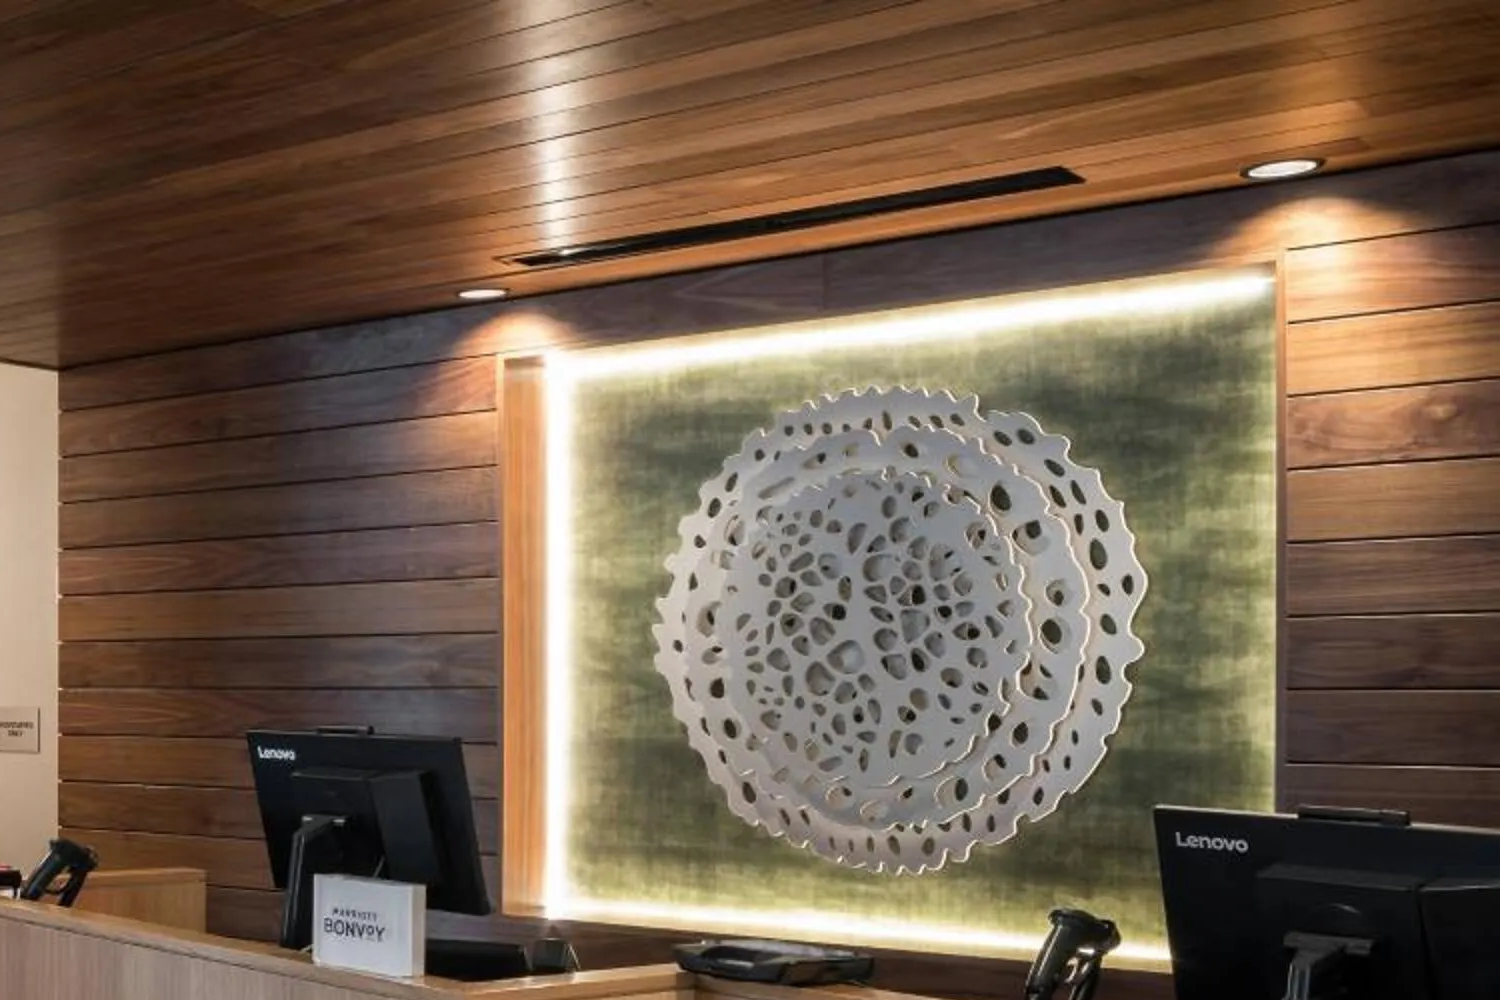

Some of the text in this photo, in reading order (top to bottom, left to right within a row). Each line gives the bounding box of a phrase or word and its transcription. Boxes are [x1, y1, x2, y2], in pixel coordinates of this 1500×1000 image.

[257, 746, 296, 761] Lenovo
[1175, 831, 1249, 853] Lenovo
[324, 917, 385, 942] BONVOY
